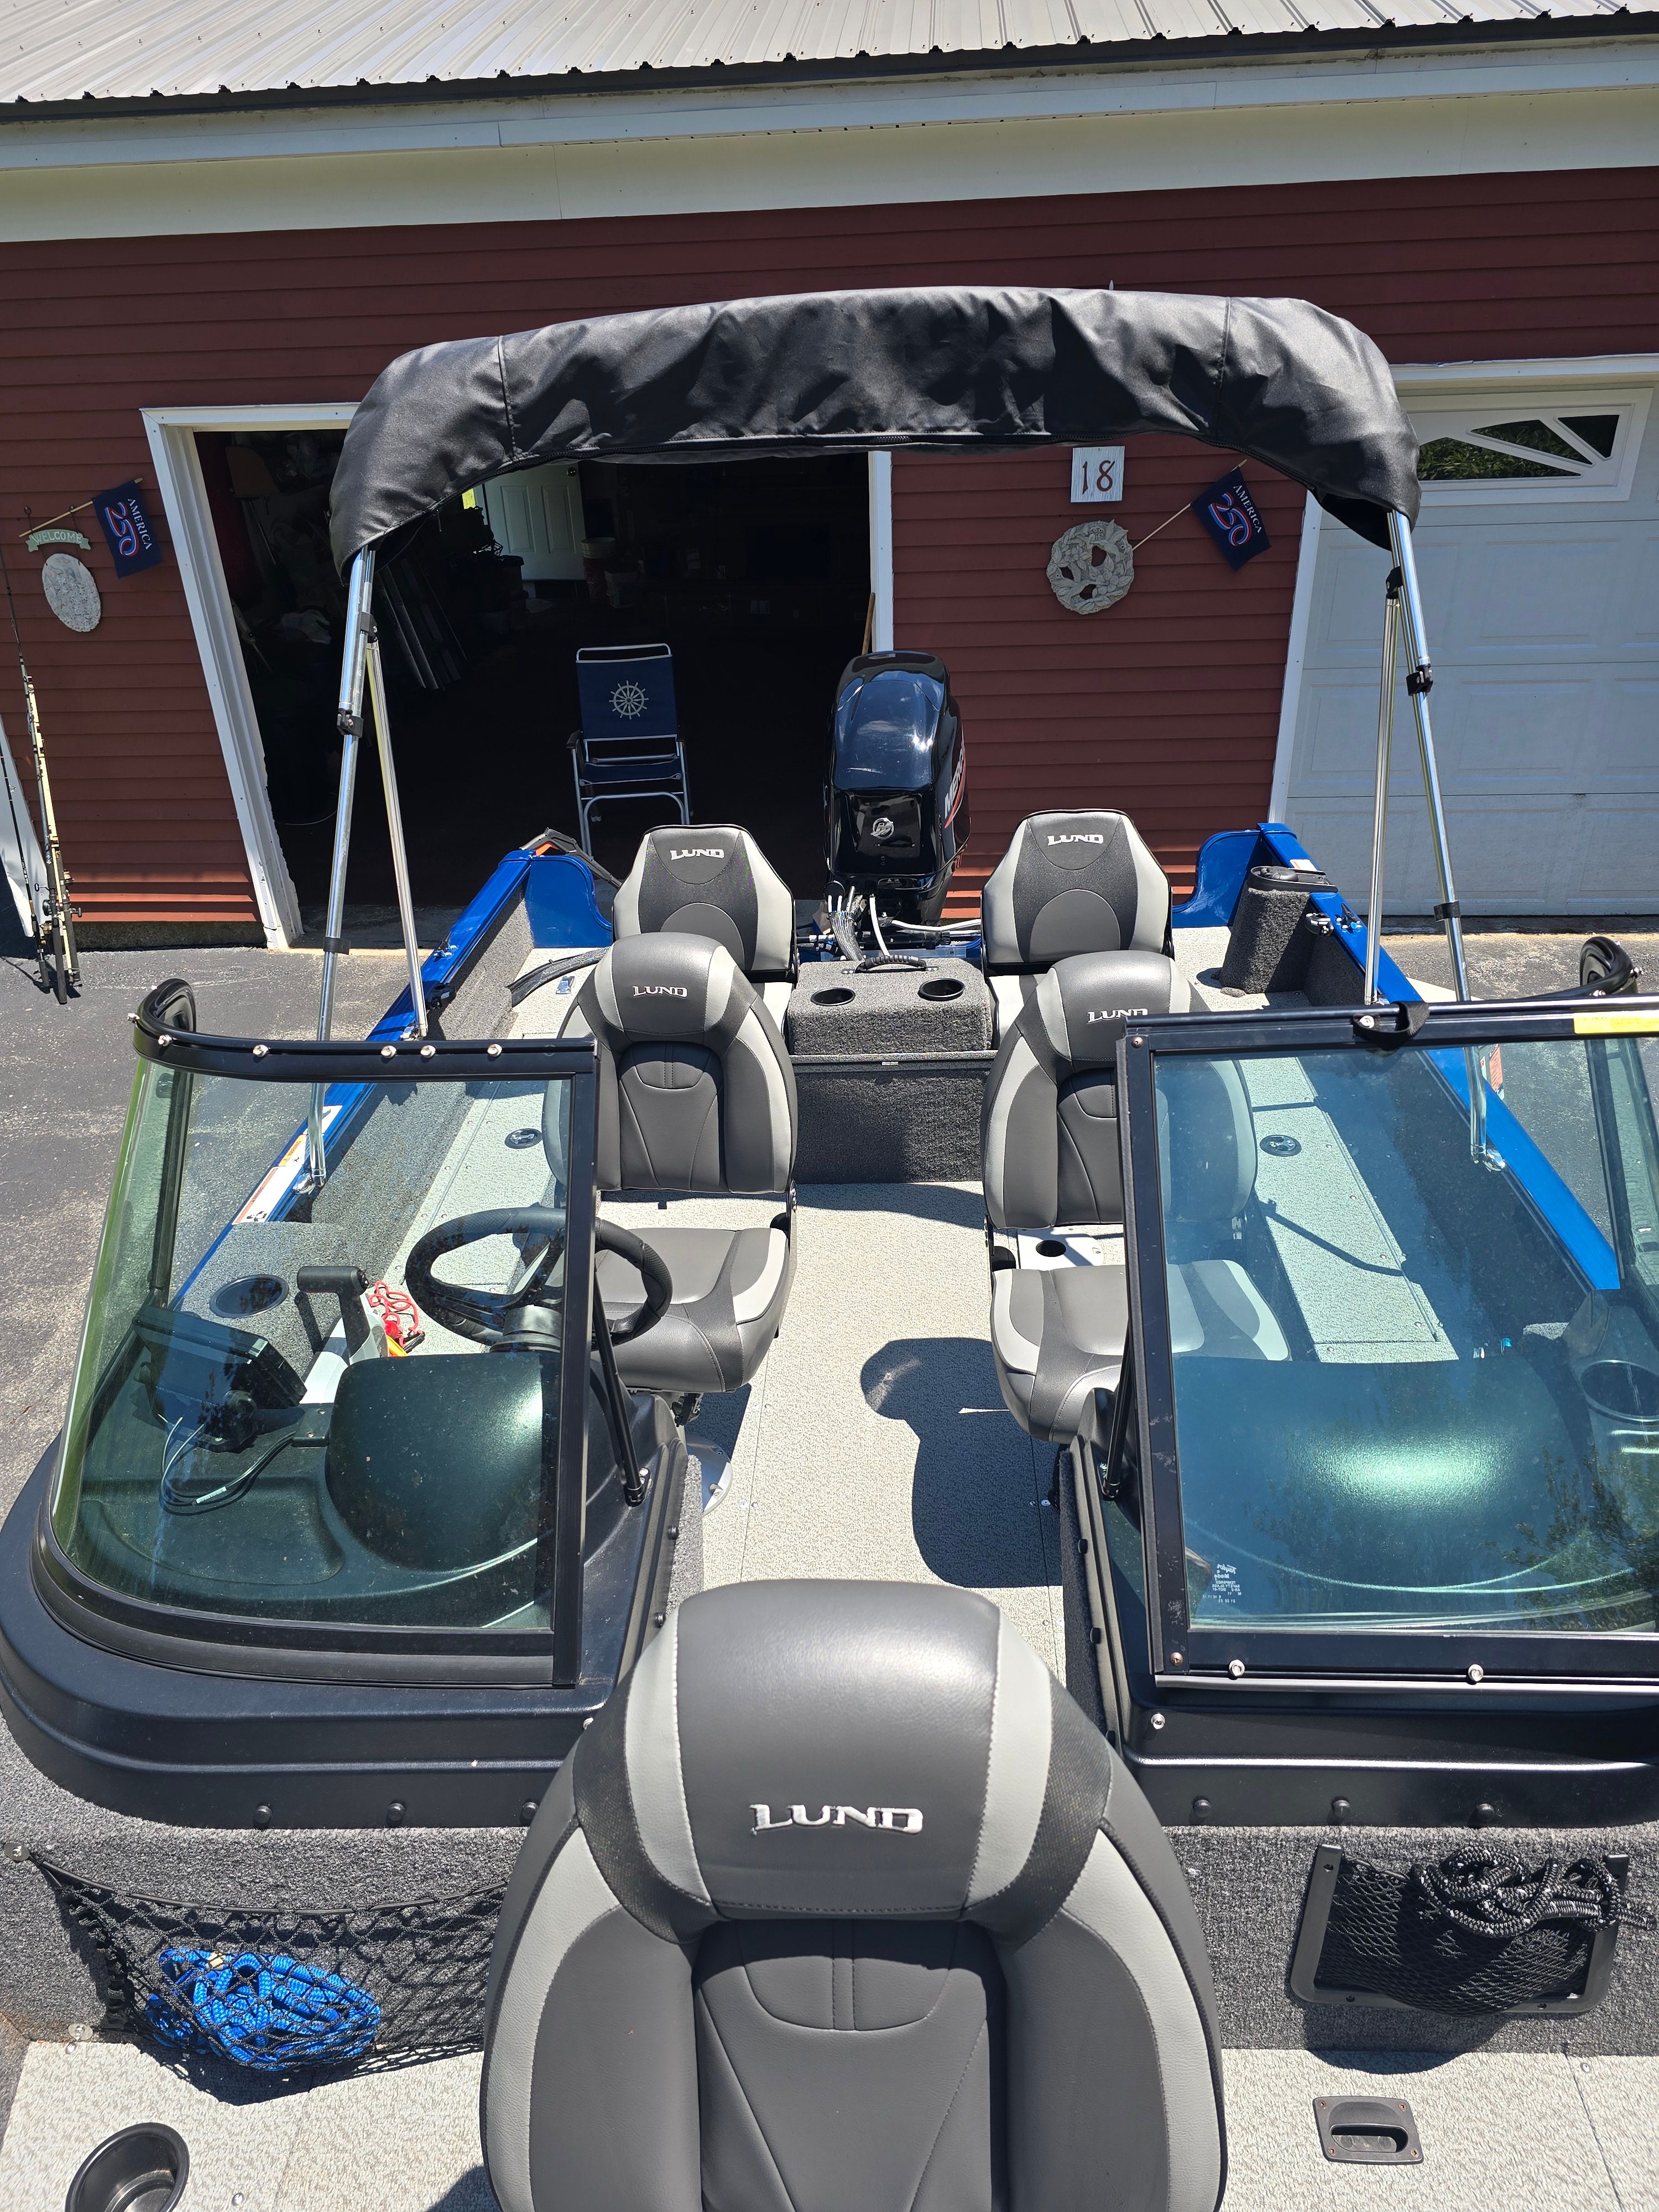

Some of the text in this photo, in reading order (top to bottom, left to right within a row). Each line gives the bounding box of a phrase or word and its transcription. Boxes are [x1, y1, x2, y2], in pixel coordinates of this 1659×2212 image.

[1082, 460, 1115, 495] 18
[127, 498, 152, 550] AMERICA
[1208, 491, 1251, 546] 250
[1233, 485, 1262, 533] AMERICA
[34, 531, 82, 544] WELCOME
[104, 501, 139, 557] 250
[670, 848, 724, 860] LUND
[1045, 834, 1104, 846] LUND
[632, 985, 687, 998] LUND
[748, 1804, 924, 1836] LUND
